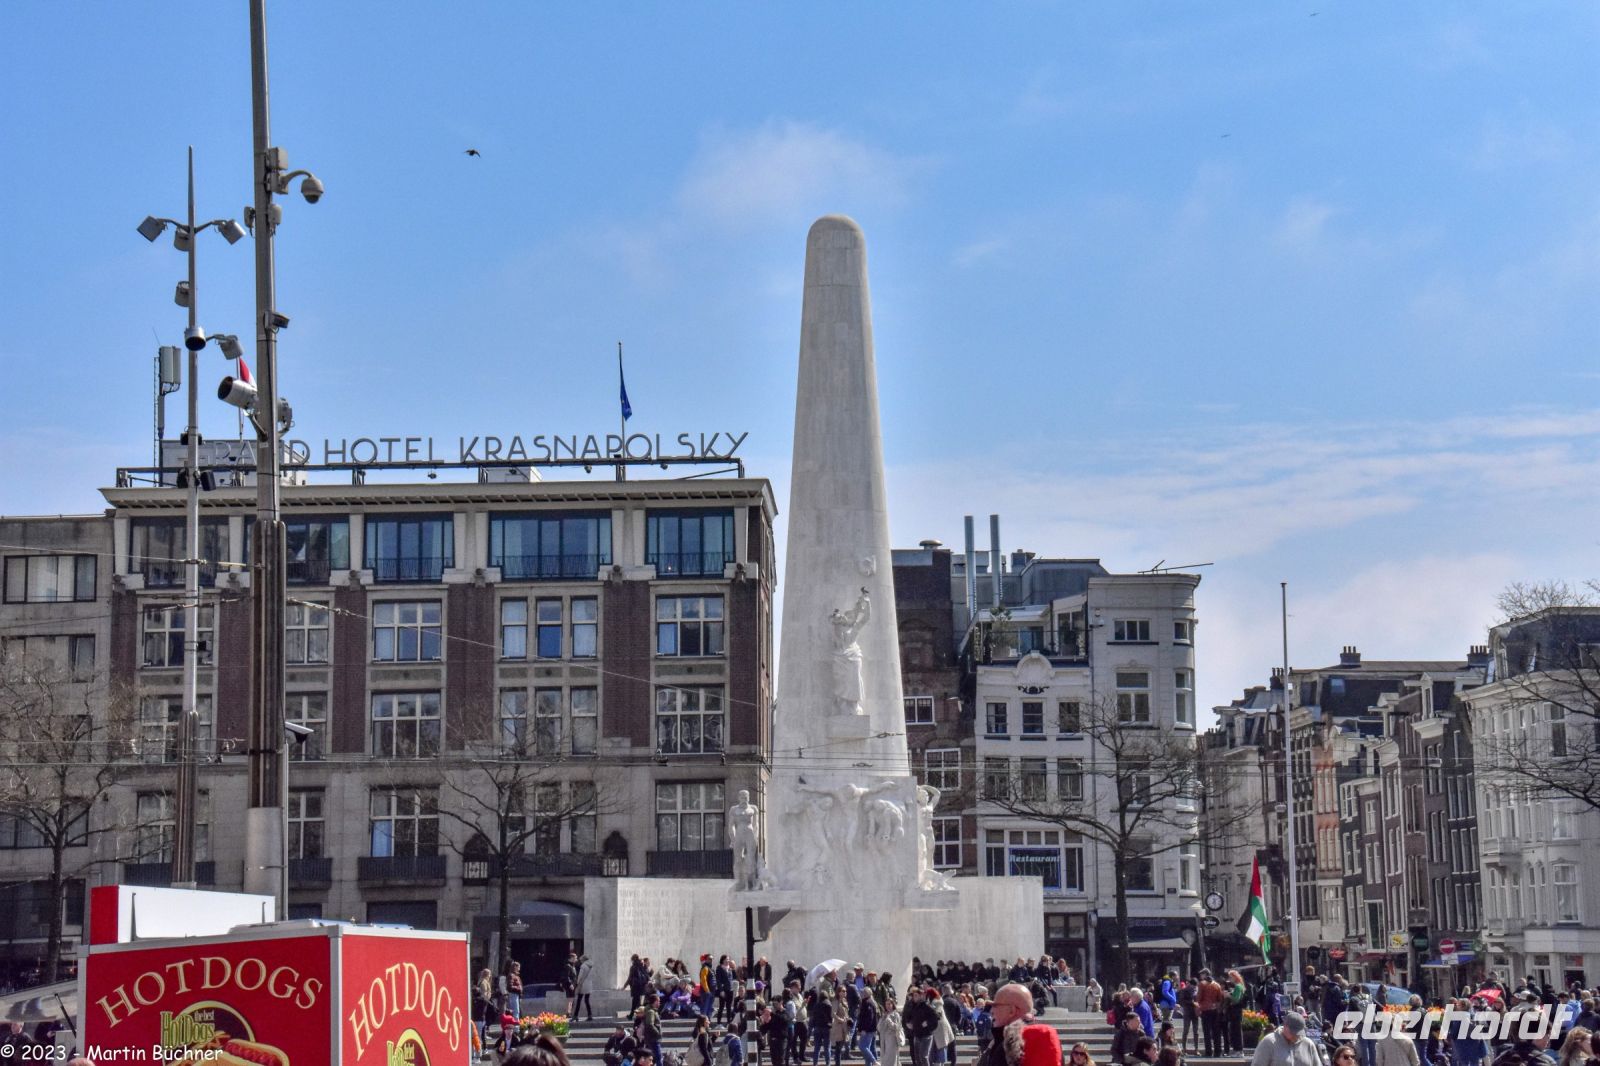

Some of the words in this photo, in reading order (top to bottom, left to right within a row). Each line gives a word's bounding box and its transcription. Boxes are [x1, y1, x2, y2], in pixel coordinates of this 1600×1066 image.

[187, 439, 311, 465] RAD
[324, 437, 445, 465] HOTEL
[460, 432, 749, 463] KRASNAPOLSKY
[95, 956, 324, 1029] HOTDOGS
[348, 961, 463, 1062] HOTDOGS
